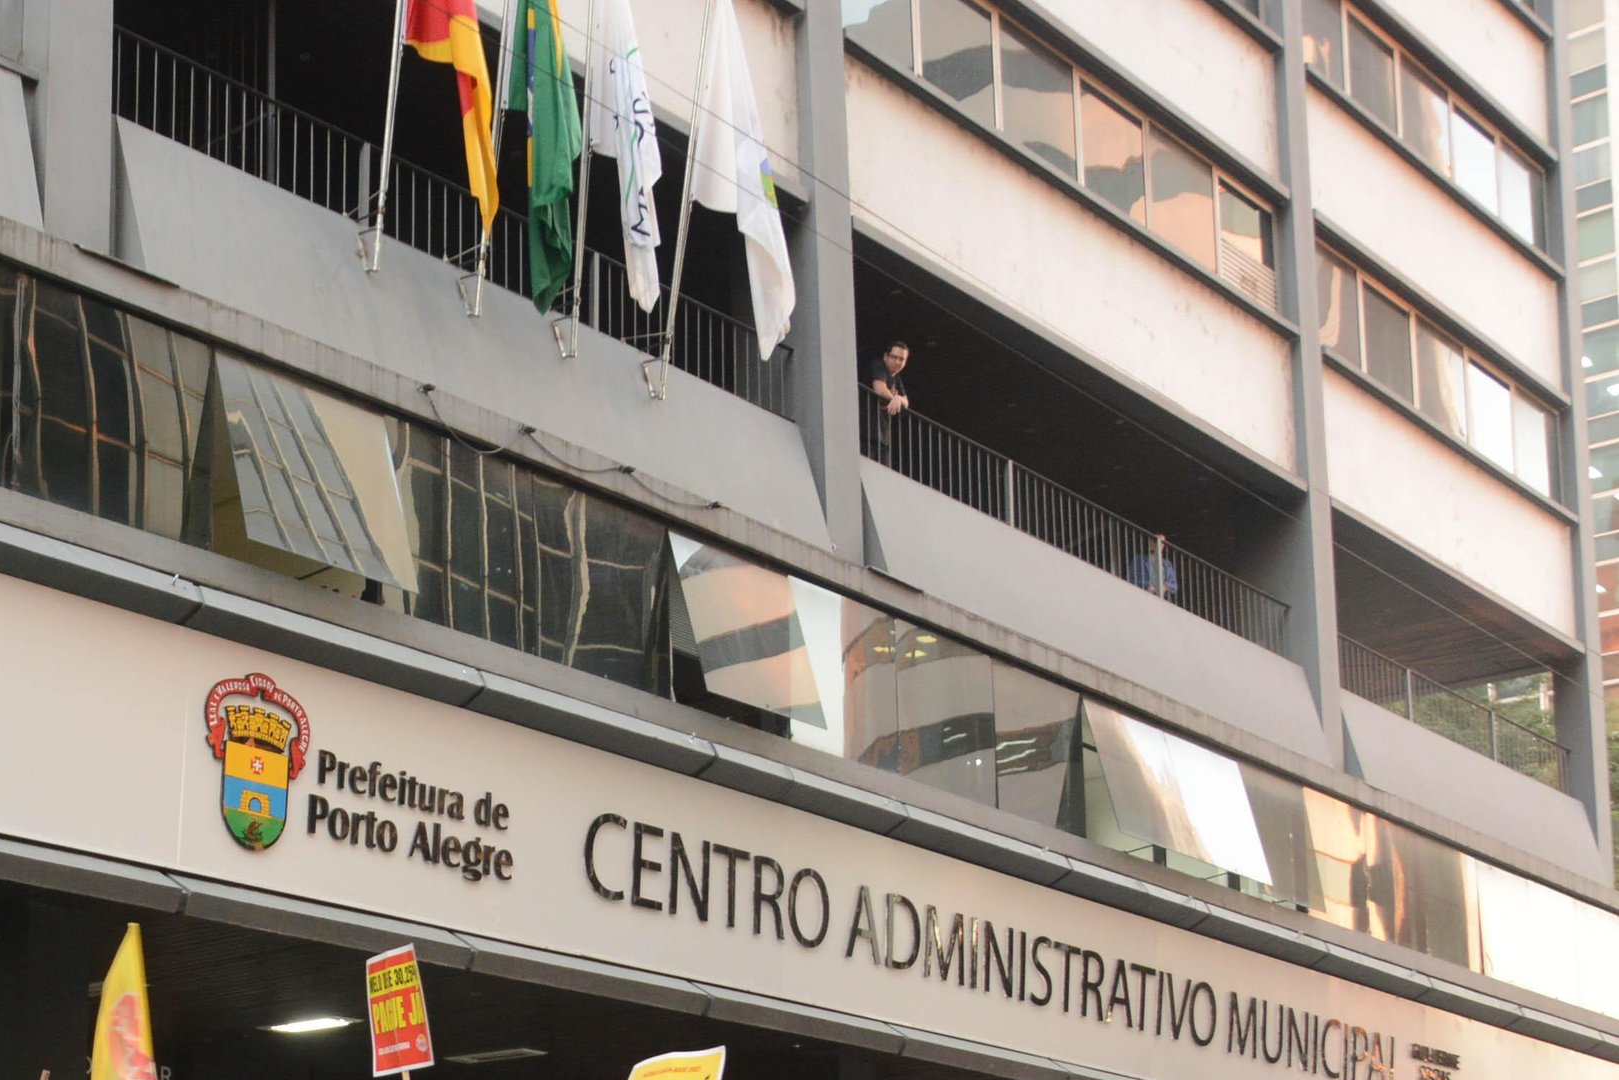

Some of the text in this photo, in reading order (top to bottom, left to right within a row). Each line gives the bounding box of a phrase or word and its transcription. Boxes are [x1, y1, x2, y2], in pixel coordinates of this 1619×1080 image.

[317, 749, 510, 831] Prefeitura de
[307, 793, 513, 882] Porto Alegre
[584, 812, 830, 949] CENTRO
[845, 884, 1217, 1048] ADMINISTRATIVO
